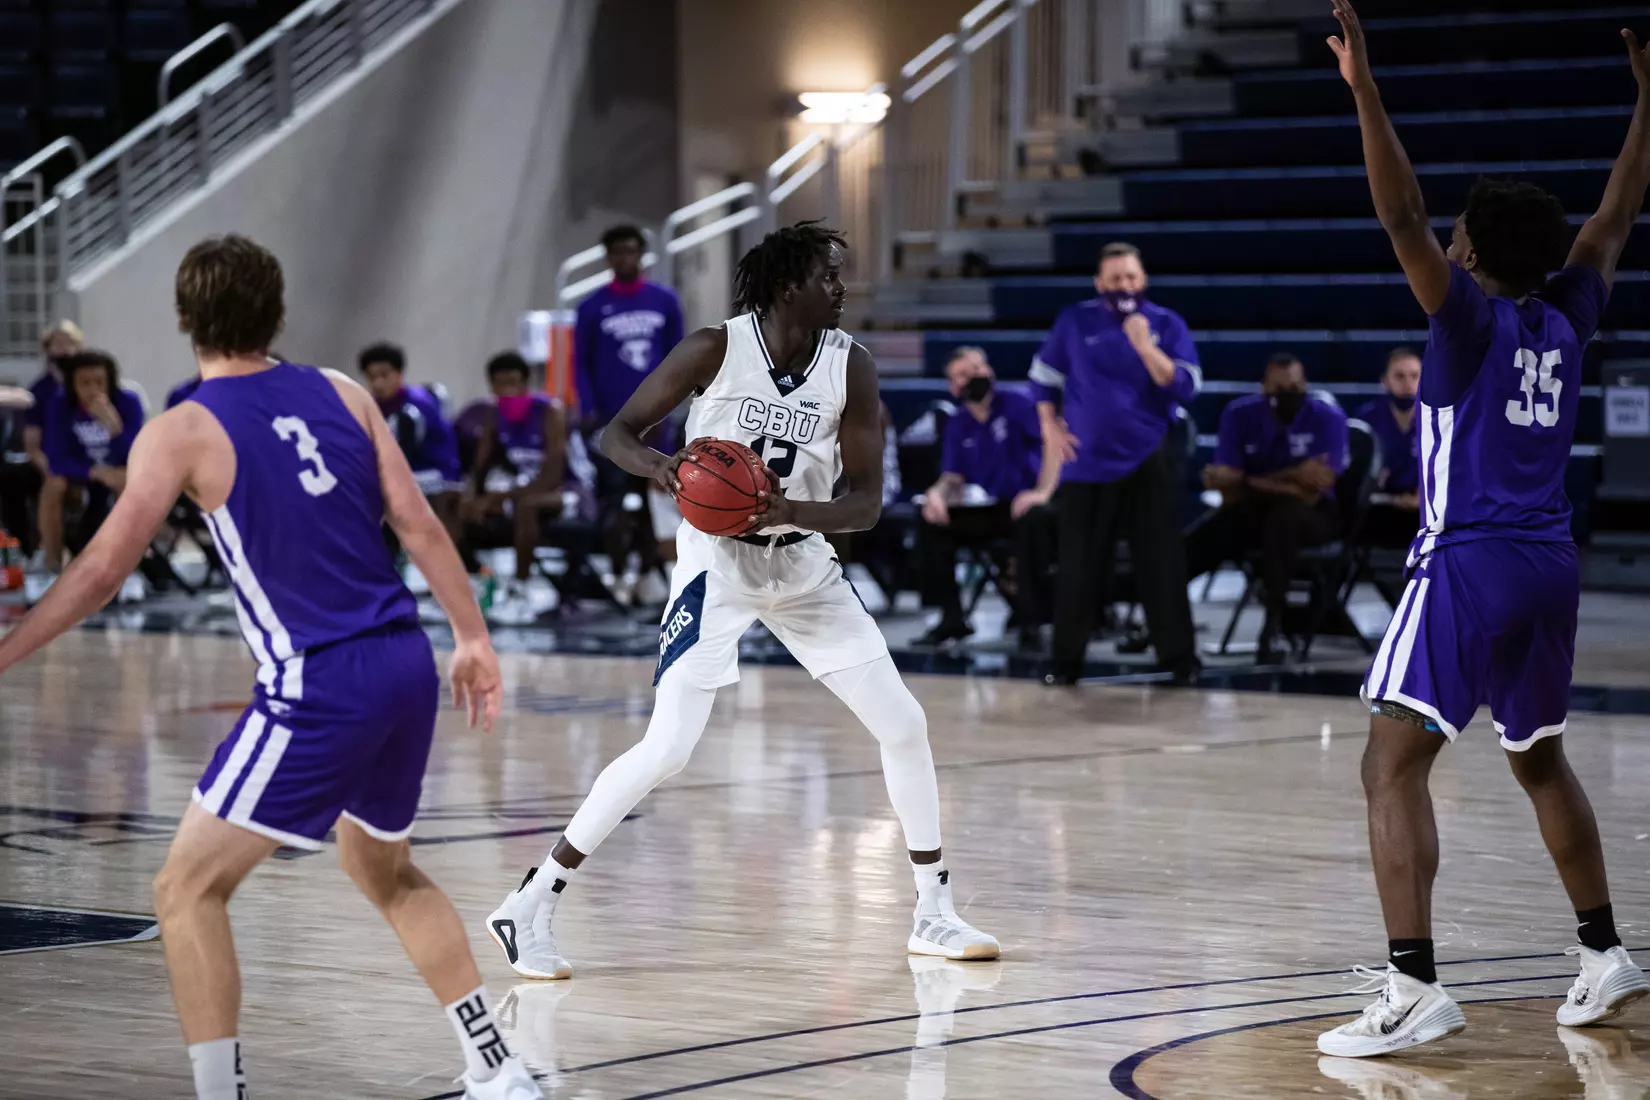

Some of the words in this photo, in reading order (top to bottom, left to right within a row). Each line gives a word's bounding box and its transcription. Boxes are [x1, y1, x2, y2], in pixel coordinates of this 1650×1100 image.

[799, 400, 820, 410] WAC
[1505, 348, 1563, 427] 35
[738, 397, 820, 444] CBU
[271, 415, 338, 497] 3
[658, 604, 693, 669] NCERS
